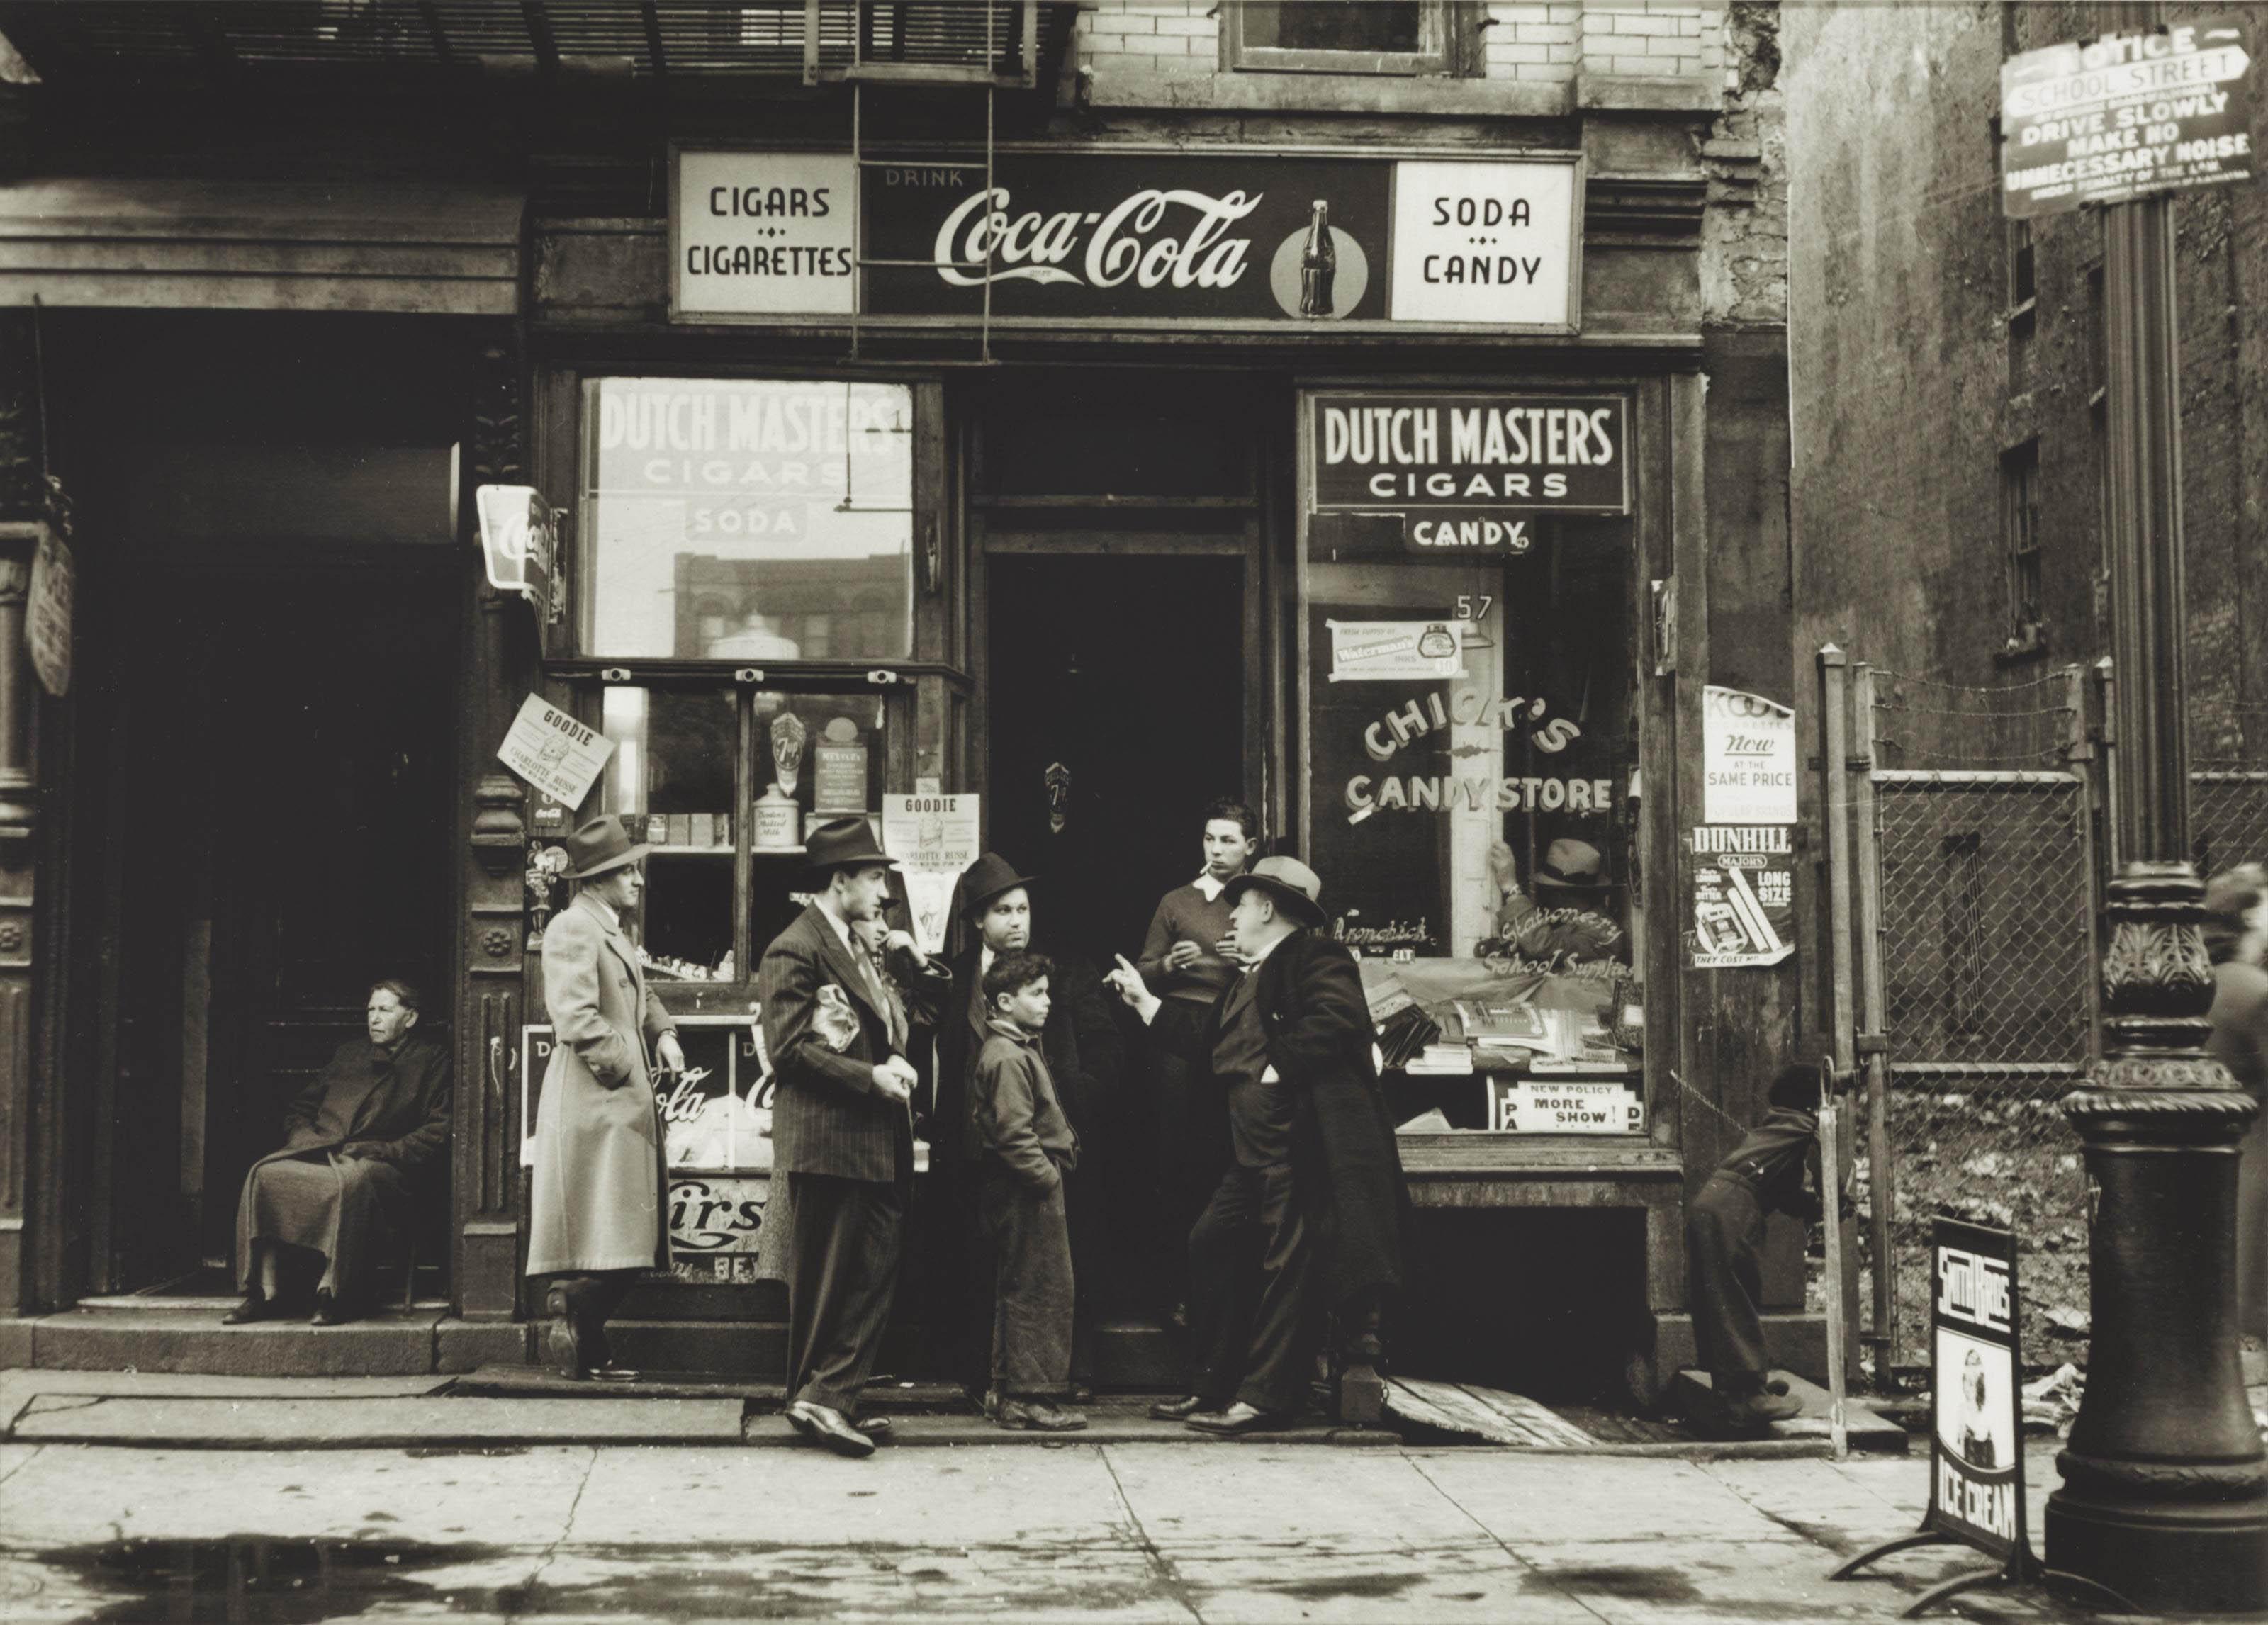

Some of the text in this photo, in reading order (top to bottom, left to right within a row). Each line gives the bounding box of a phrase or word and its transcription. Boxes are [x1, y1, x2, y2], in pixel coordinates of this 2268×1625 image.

[2021, 72, 2118, 111] SCHOOL
[2130, 54, 2228, 89] STREET
[2021, 113, 2105, 147] DRIVE
[2117, 92, 2229, 128] SLOWLY
[2067, 123, 2180, 157] MAKE NO
[2007, 133, 2252, 191] UNNECESSARY NOISE
[886, 169, 964, 187] DRINK
[710, 187, 830, 217] CIGARS
[1432, 198, 1531, 227] SODA
[934, 187, 1264, 289] Coca-Cola
[687, 246, 853, 276] CIGARETTES
[1423, 255, 1542, 285] CANDY
[601, 393, 893, 456] DUTCH MASTERS
[1325, 407, 1614, 466] DUTCH MASTERS
[644, 459, 848, 486] CIGARS
[1369, 473, 1568, 497] CIGARS
[695, 509, 797, 534] SODA
[1413, 521, 1526, 546] CANDY
[1456, 595, 1493, 619] 57
[544, 709, 594, 747] GOODIE
[1364, 685, 1581, 761] CHICK'S
[1725, 734, 1775, 752] Now
[1734, 760, 1765, 770] AT THE
[1708, 772, 1792, 787] SAME PRICE
[905, 798, 957, 813] GOODIE
[1345, 775, 1612, 813] CANDY STORE
[1692, 826, 1792, 853] DUNHILL
[1722, 857, 1764, 866] MAJORS
[1757, 870, 1792, 887] LONG
[1758, 887, 1792, 903] SIZE
[1483, 948, 1564, 978] School
[1695, 955, 1717, 965] THEY
[1720, 955, 1744, 965] COST
[1530, 1084, 1614, 1094] NEW POLICY
[1534, 1098, 1585, 1109] MORE
[1938, 1453, 2016, 1542] ICE CREAM
